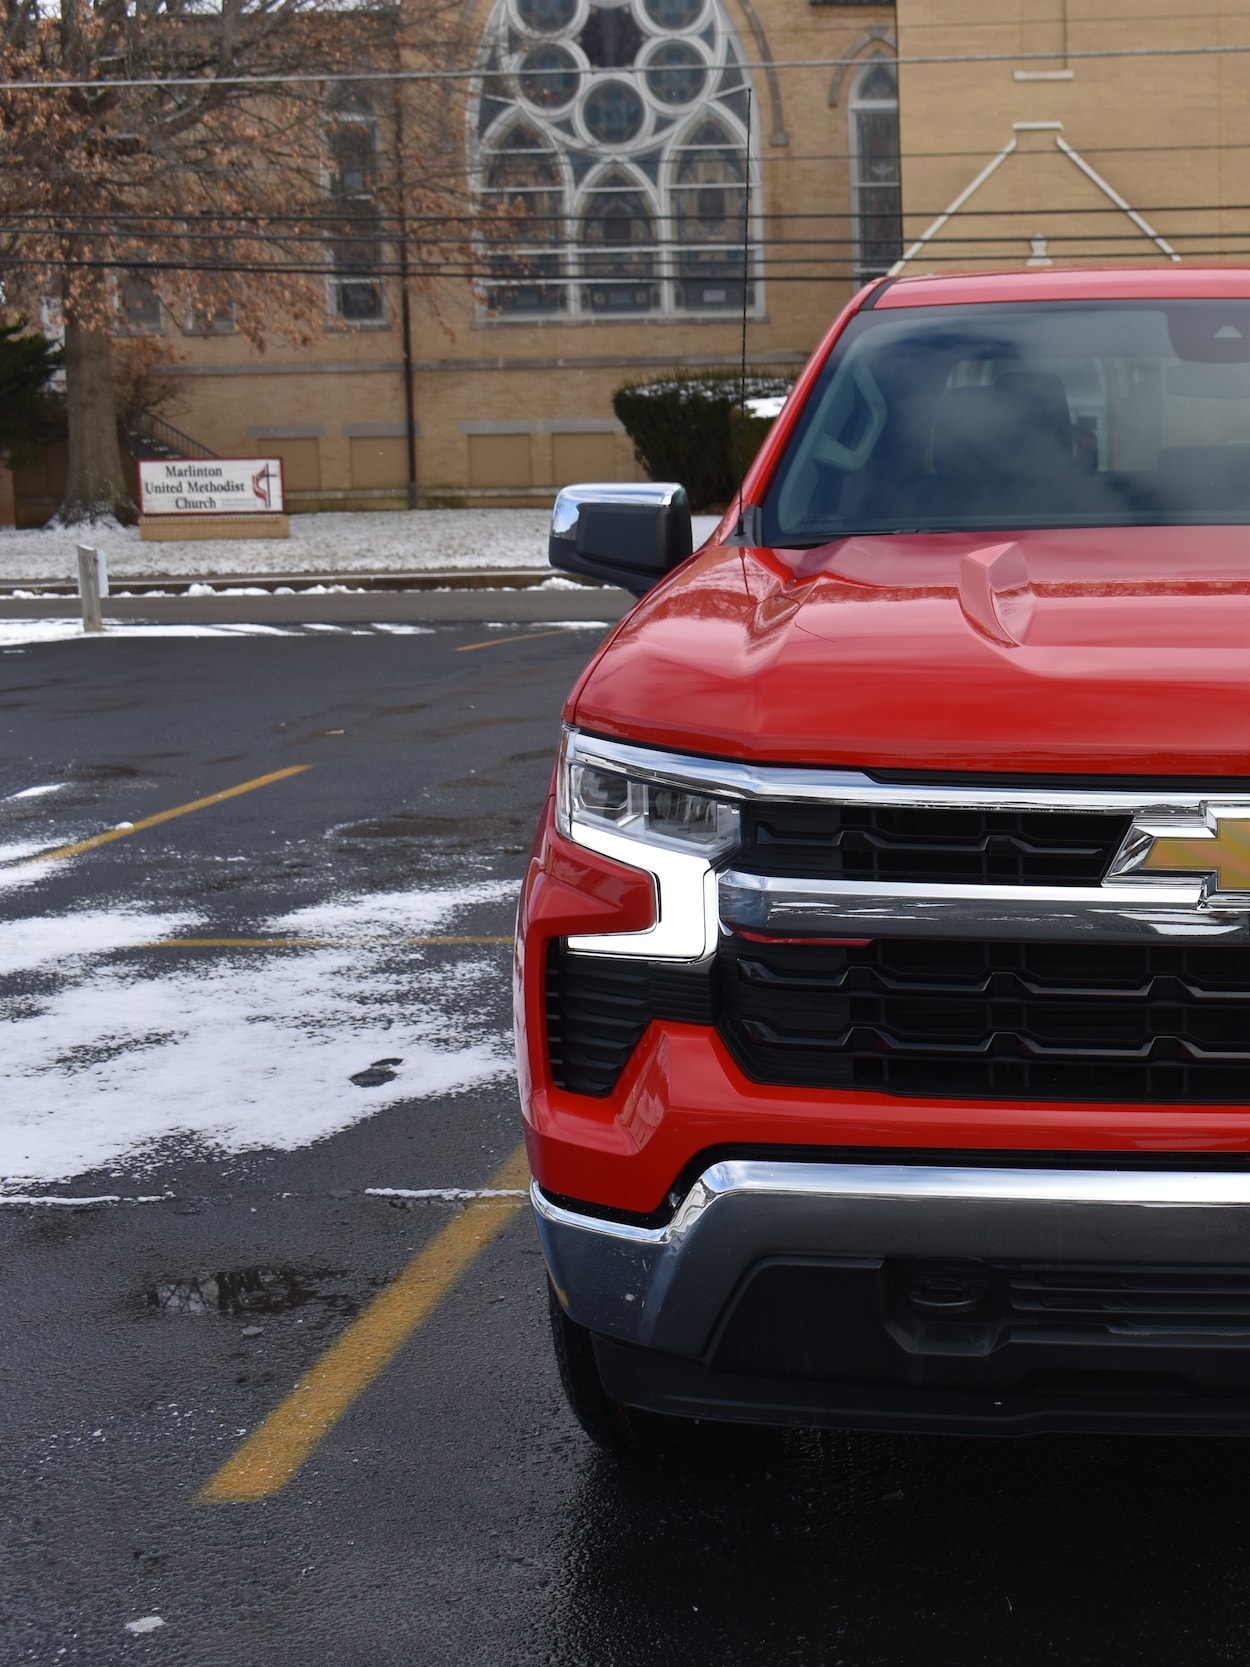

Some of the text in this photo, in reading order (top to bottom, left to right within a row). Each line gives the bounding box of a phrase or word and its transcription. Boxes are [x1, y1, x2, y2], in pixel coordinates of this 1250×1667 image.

[166, 465, 223, 477] Marlinton
[145, 480, 245, 494] United Methodist
[175, 497, 216, 509] Church
